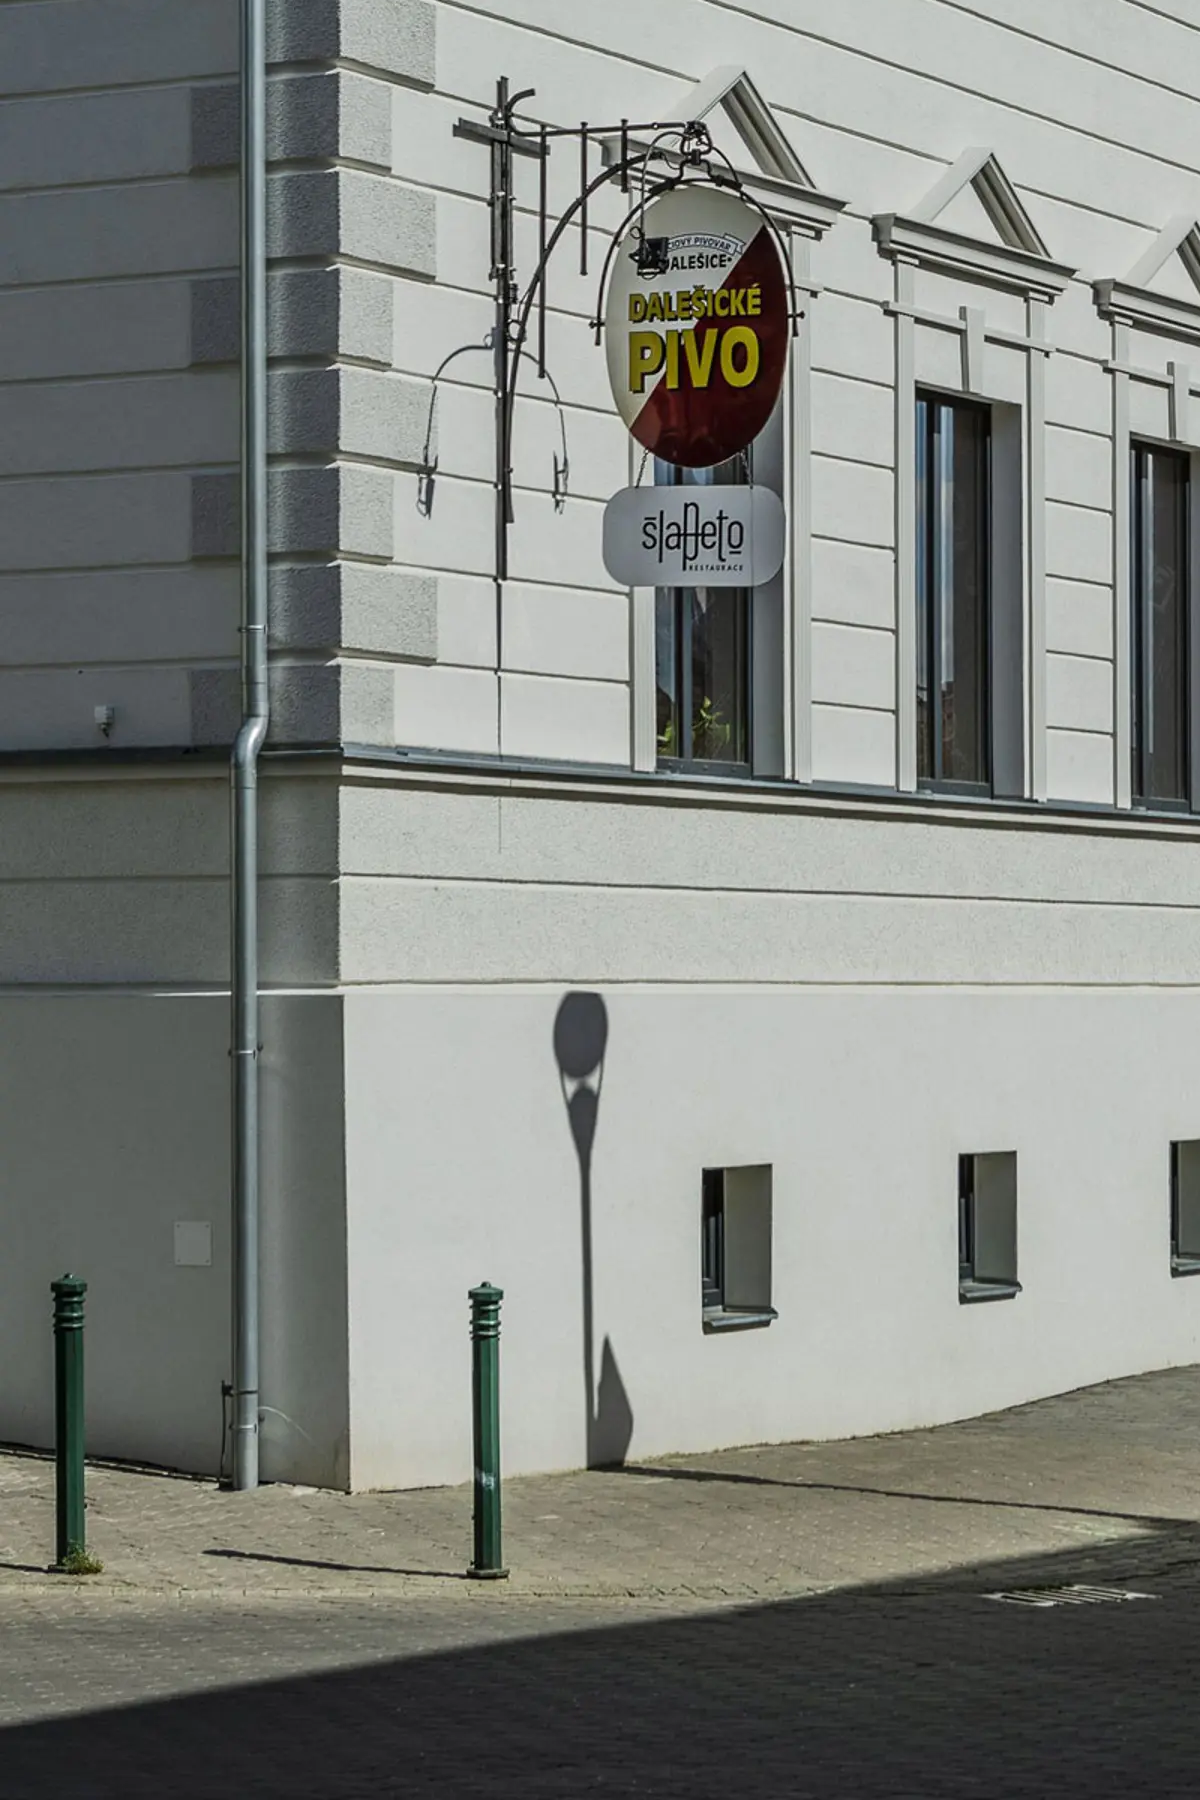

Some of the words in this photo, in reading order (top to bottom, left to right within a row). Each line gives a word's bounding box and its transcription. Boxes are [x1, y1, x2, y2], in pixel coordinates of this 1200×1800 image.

[628, 284, 762, 324] DALEŠICKÉ
[628, 325, 761, 394] PIVO
[689, 564, 744, 572] RESTAURACE
